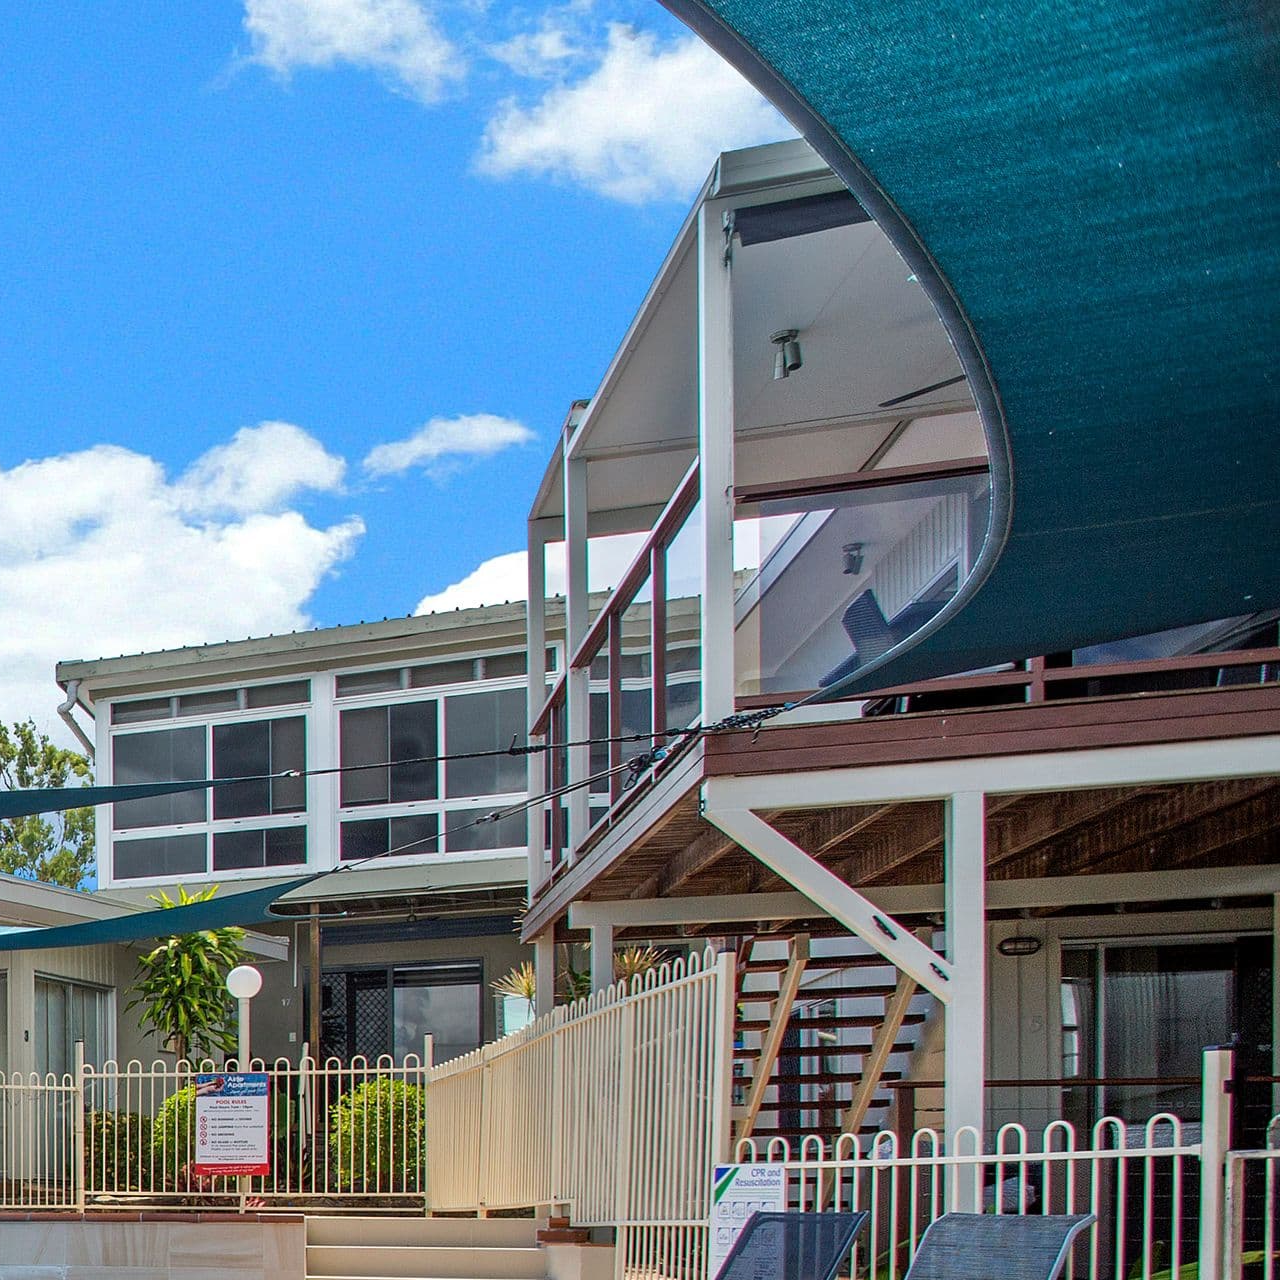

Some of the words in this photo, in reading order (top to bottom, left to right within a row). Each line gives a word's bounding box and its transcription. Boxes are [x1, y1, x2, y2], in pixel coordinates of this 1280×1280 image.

[24, 1030, 29, 1042] 3
[751, 1168, 766, 1177] CPR
[767, 1168, 781, 1177] and
[735, 1178, 780, 1187] Resuscitation
